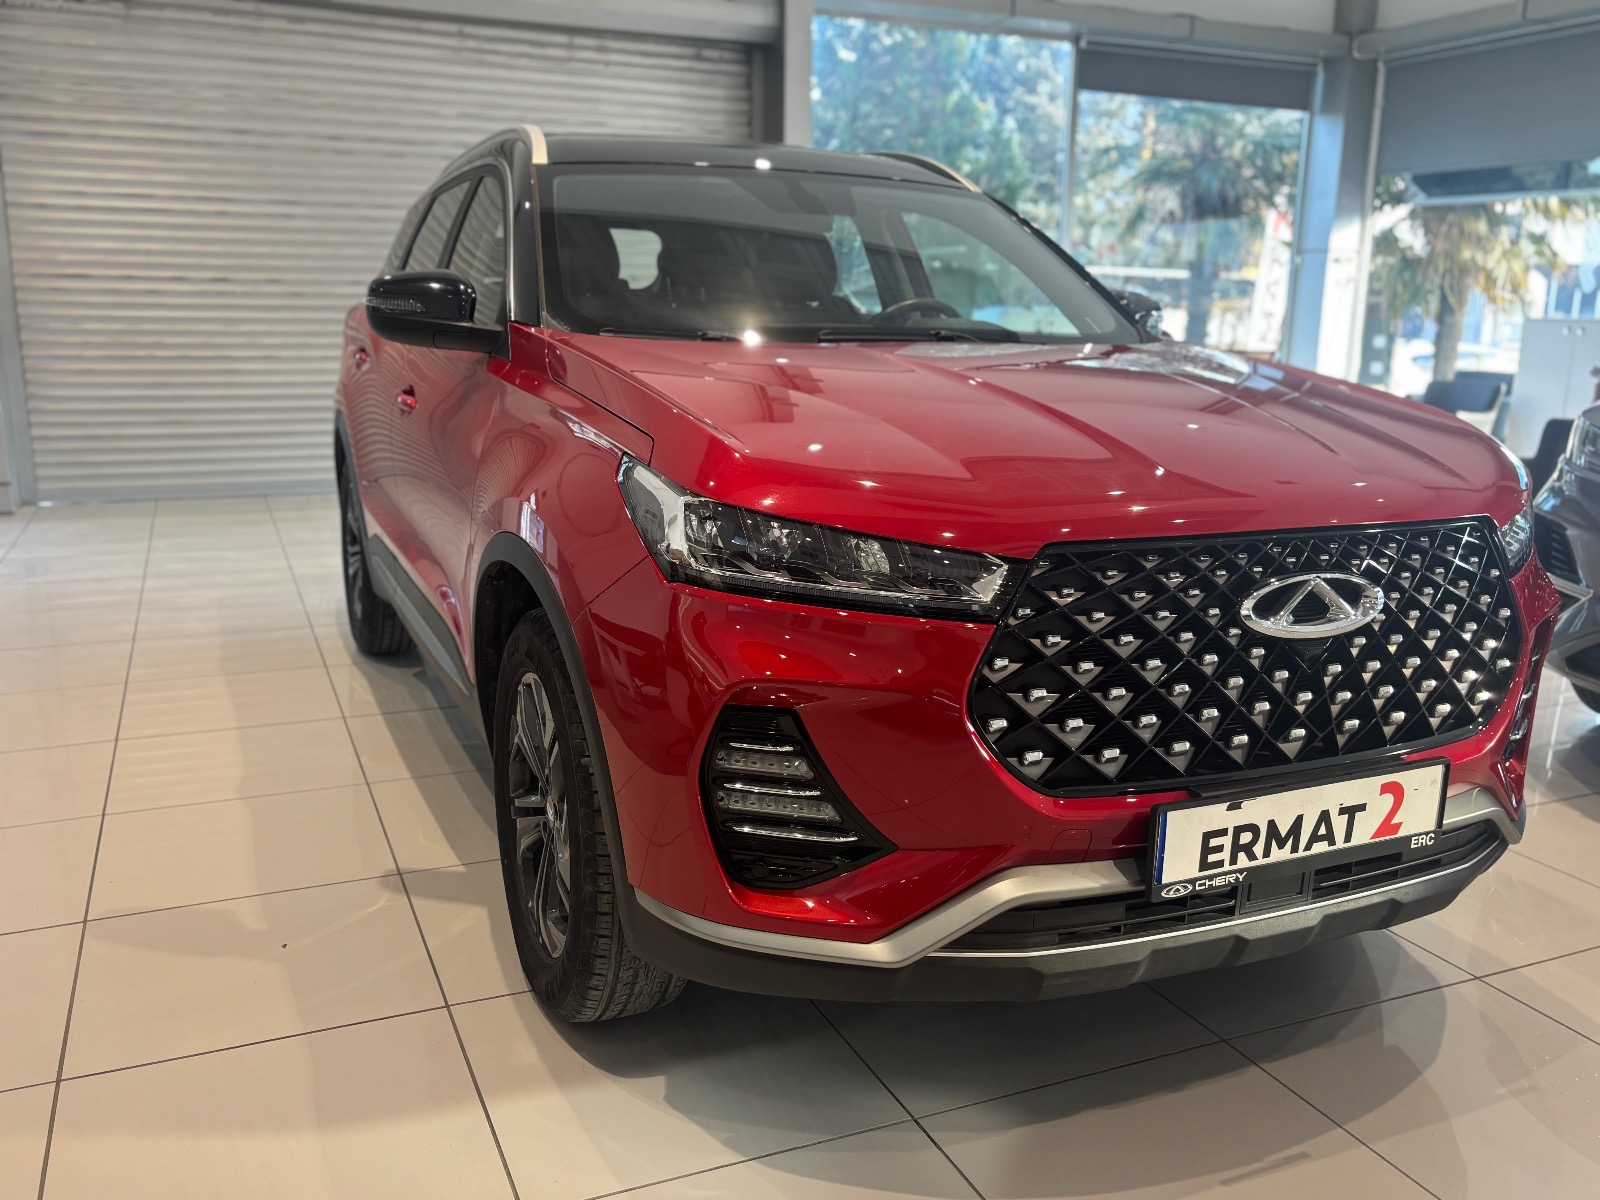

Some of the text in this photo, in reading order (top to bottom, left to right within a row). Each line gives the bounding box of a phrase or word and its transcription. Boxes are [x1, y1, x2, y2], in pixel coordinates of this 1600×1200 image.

[1198, 780, 1405, 873] ERMAT 2
[1410, 832, 1435, 849] ERC
[1195, 871, 1248, 891] CHERY
